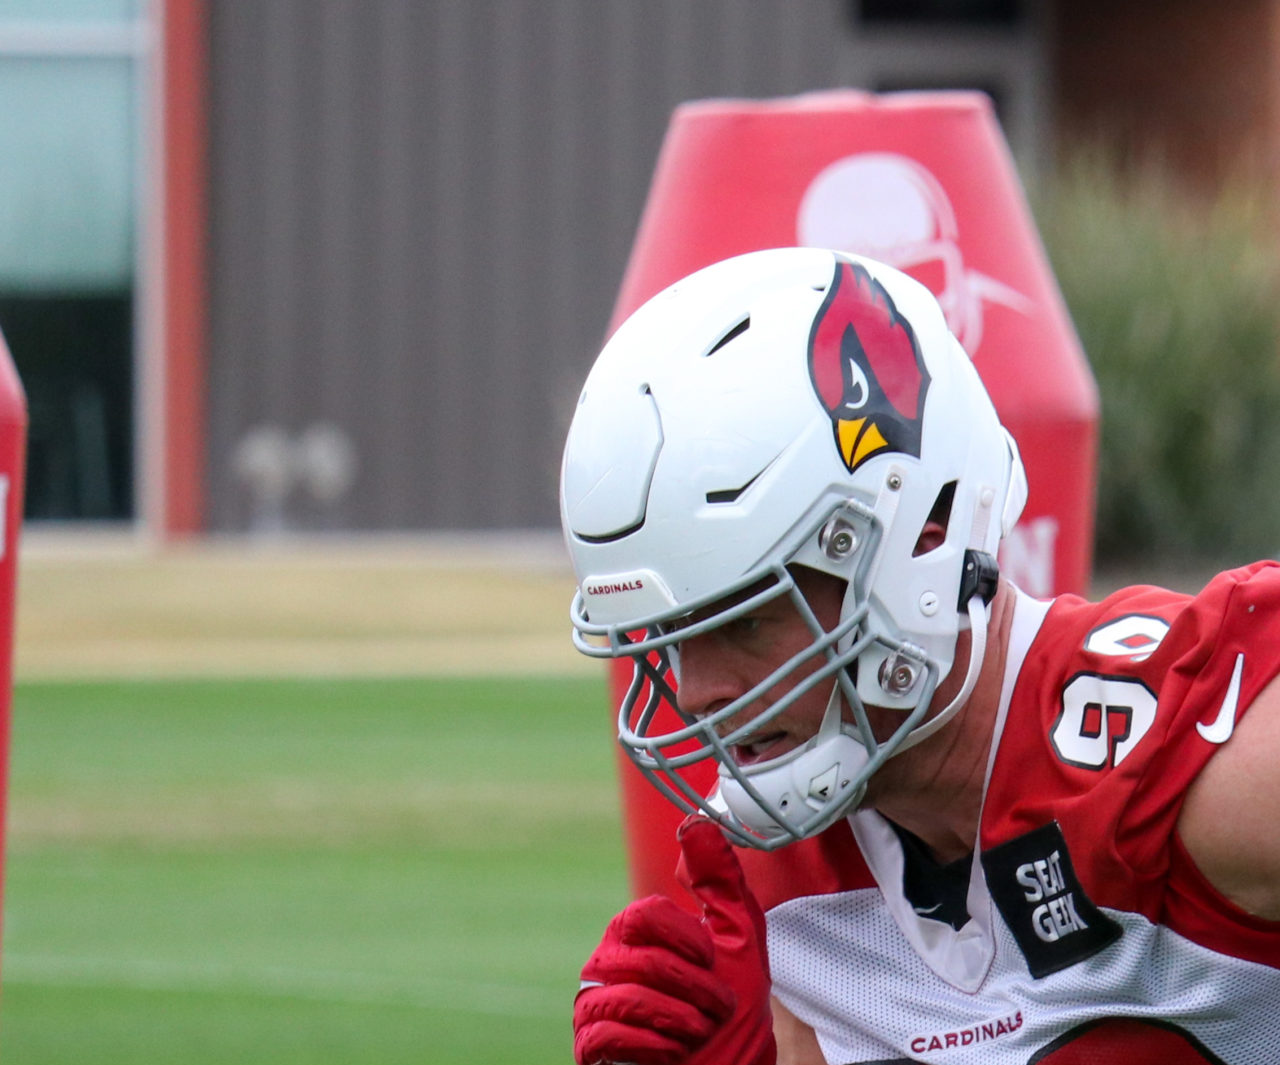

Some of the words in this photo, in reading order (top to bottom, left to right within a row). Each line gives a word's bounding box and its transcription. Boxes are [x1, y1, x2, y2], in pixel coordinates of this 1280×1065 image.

[587, 580, 643, 595] CARDINALS
[1016, 850, 1065, 902] SEAT
[1032, 893, 1088, 942] GEEK
[911, 1011, 1023, 1053] CARDINALS
